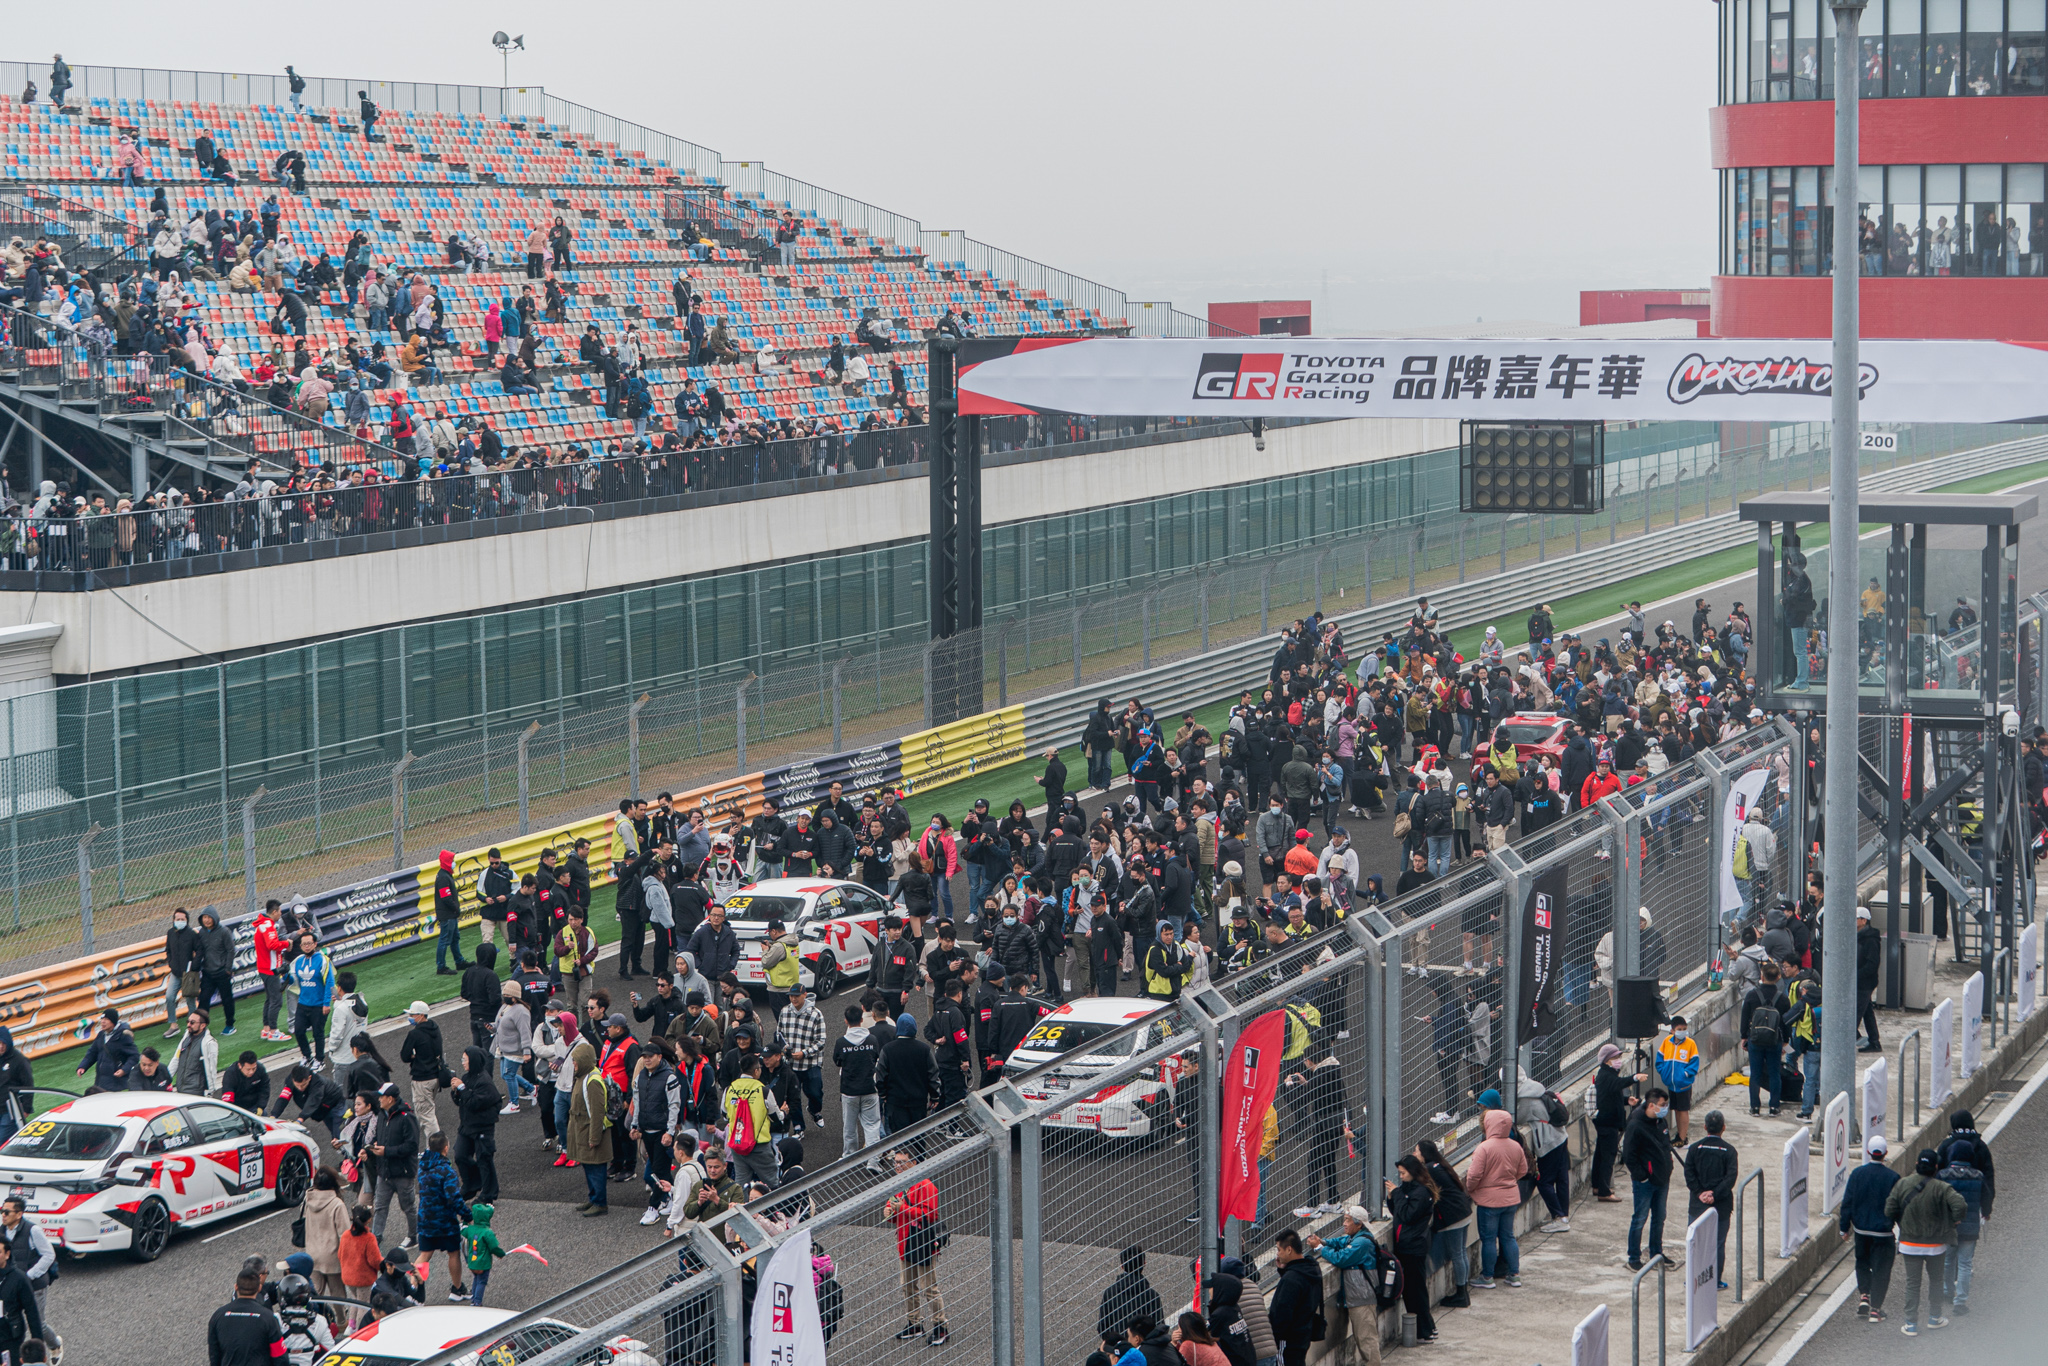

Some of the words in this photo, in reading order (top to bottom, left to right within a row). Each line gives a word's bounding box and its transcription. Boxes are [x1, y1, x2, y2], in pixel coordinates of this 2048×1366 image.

[1290, 354, 1385, 368] TOYOTA
[1196, 371, 1276, 398] GR
[1286, 370, 1375, 384] GAZOO
[1393, 354, 1645, 400] 品牌嘉年華
[1669, 354, 1807, 403] COROLLA
[1283, 386, 1370, 404] Racing
[1864, 435, 1894, 448] 200
[725, 897, 753, 908] 83
[1537, 894, 1547, 926] GR
[1535, 934, 1545, 982] Taiwan
[1028, 1026, 1066, 1040] 26
[842, 1045, 874, 1053] SWOOSH
[18, 1121, 56, 1137] 89
[162, 1115, 182, 1136] 89
[246, 1163, 258, 1179] 89
